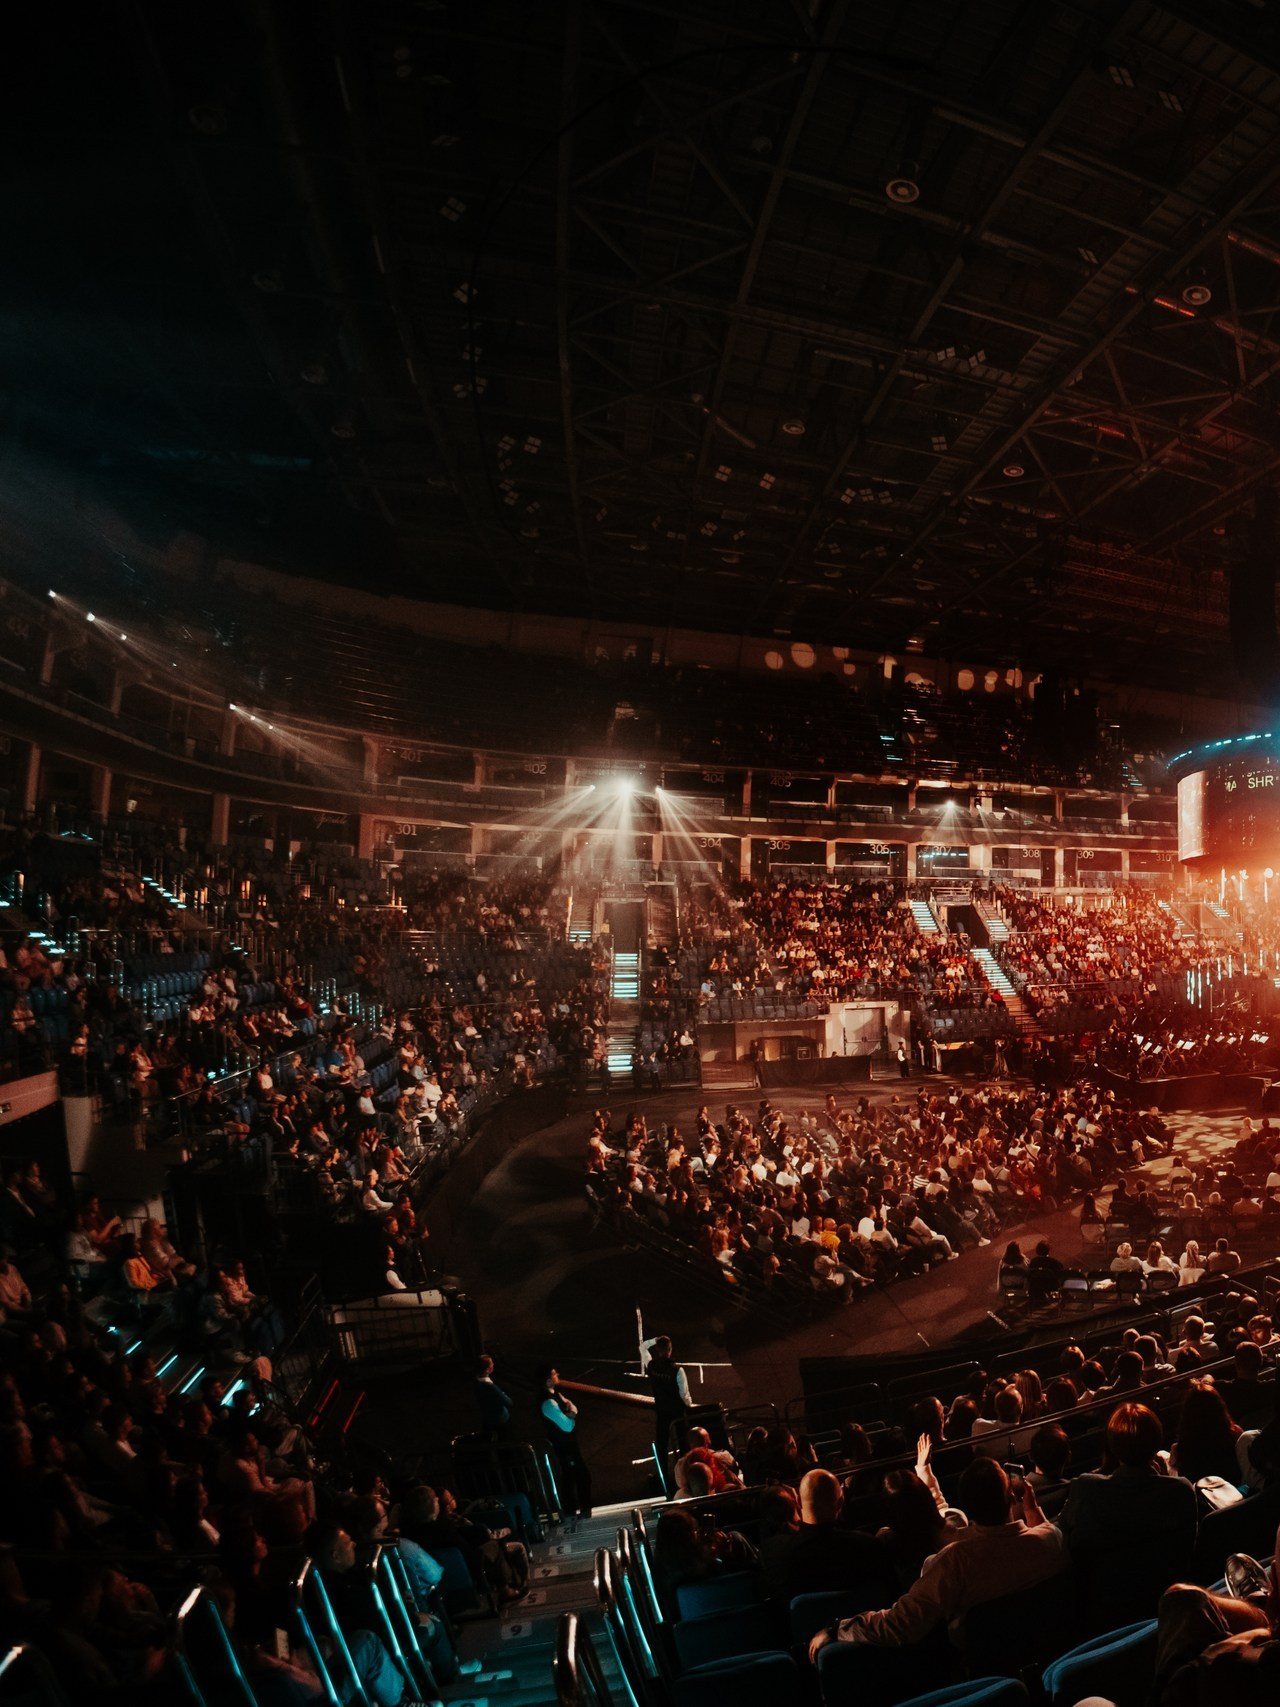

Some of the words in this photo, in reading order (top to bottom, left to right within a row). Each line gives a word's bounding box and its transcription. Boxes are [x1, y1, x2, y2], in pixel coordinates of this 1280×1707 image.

[400, 749, 423, 763] 401
[1248, 775, 1274, 789] SHR
[395, 823, 417, 836] 301
[520, 831, 542, 843] 302
[700, 838, 722, 848] 304
[769, 840, 791, 851] 305
[869, 843, 890, 854] 306
[1022, 849, 1041, 858] 308
[1077, 850, 1094, 859] 309
[1156, 854, 1171, 862] 310
[556, 1546, 565, 1555] 3
[541, 1568, 552, 1577] 4
[527, 1593, 538, 1603] 5
[510, 1624, 522, 1636] 6
